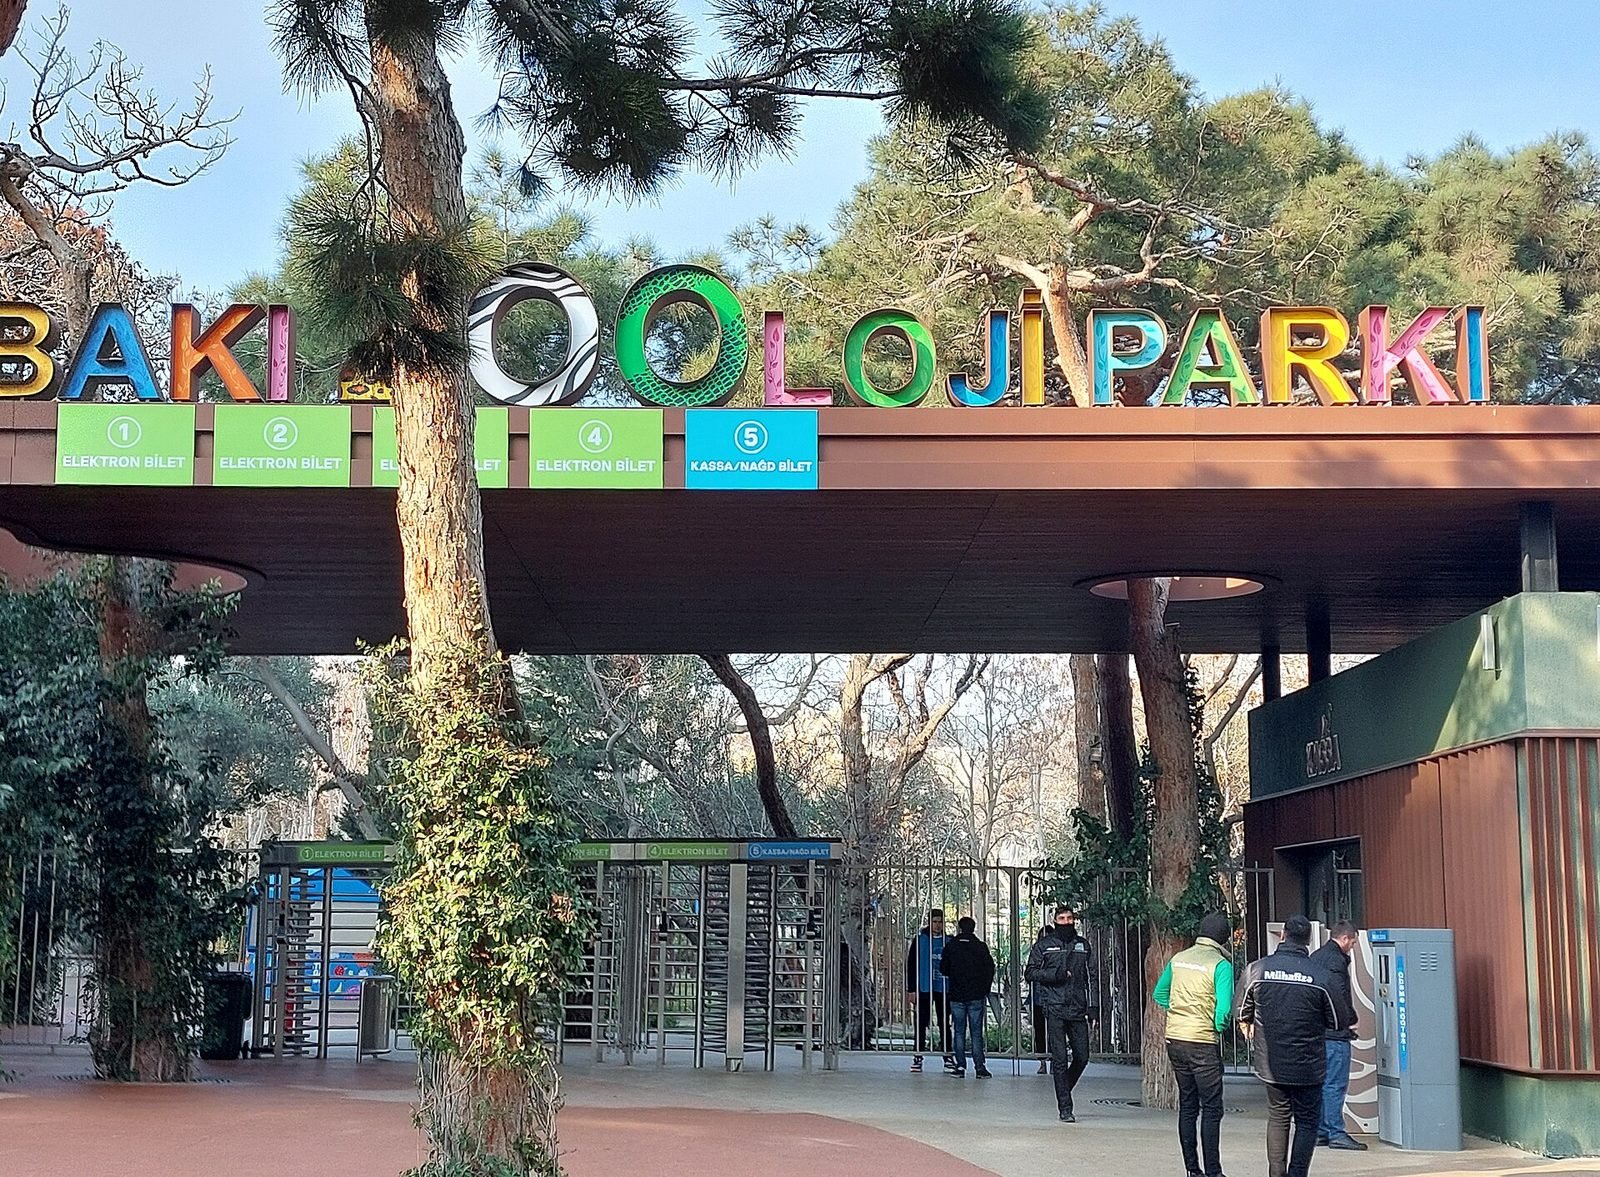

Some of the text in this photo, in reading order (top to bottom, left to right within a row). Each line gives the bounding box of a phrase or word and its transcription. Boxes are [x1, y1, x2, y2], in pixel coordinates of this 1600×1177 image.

[0, 261, 1490, 407] BAKI OOLOJİ PARKI
[118, 423, 130, 441] 1
[272, 423, 288, 443] 2
[587, 426, 602, 446] 4
[743, 427, 759, 447] 5
[62, 453, 185, 469] ELEKTRON BİLET
[219, 454, 342, 470] ELEKTRON BİLET
[474, 459, 502, 471] LET
[536, 456, 656, 472] ELEKTRON BİLET
[690, 458, 813, 472] KASSA/NAĞD BİLET
[315, 850, 358, 858] ELEKTRON
[359, 848, 383, 858] BİLET
[662, 848, 705, 856] ELEKTRON
